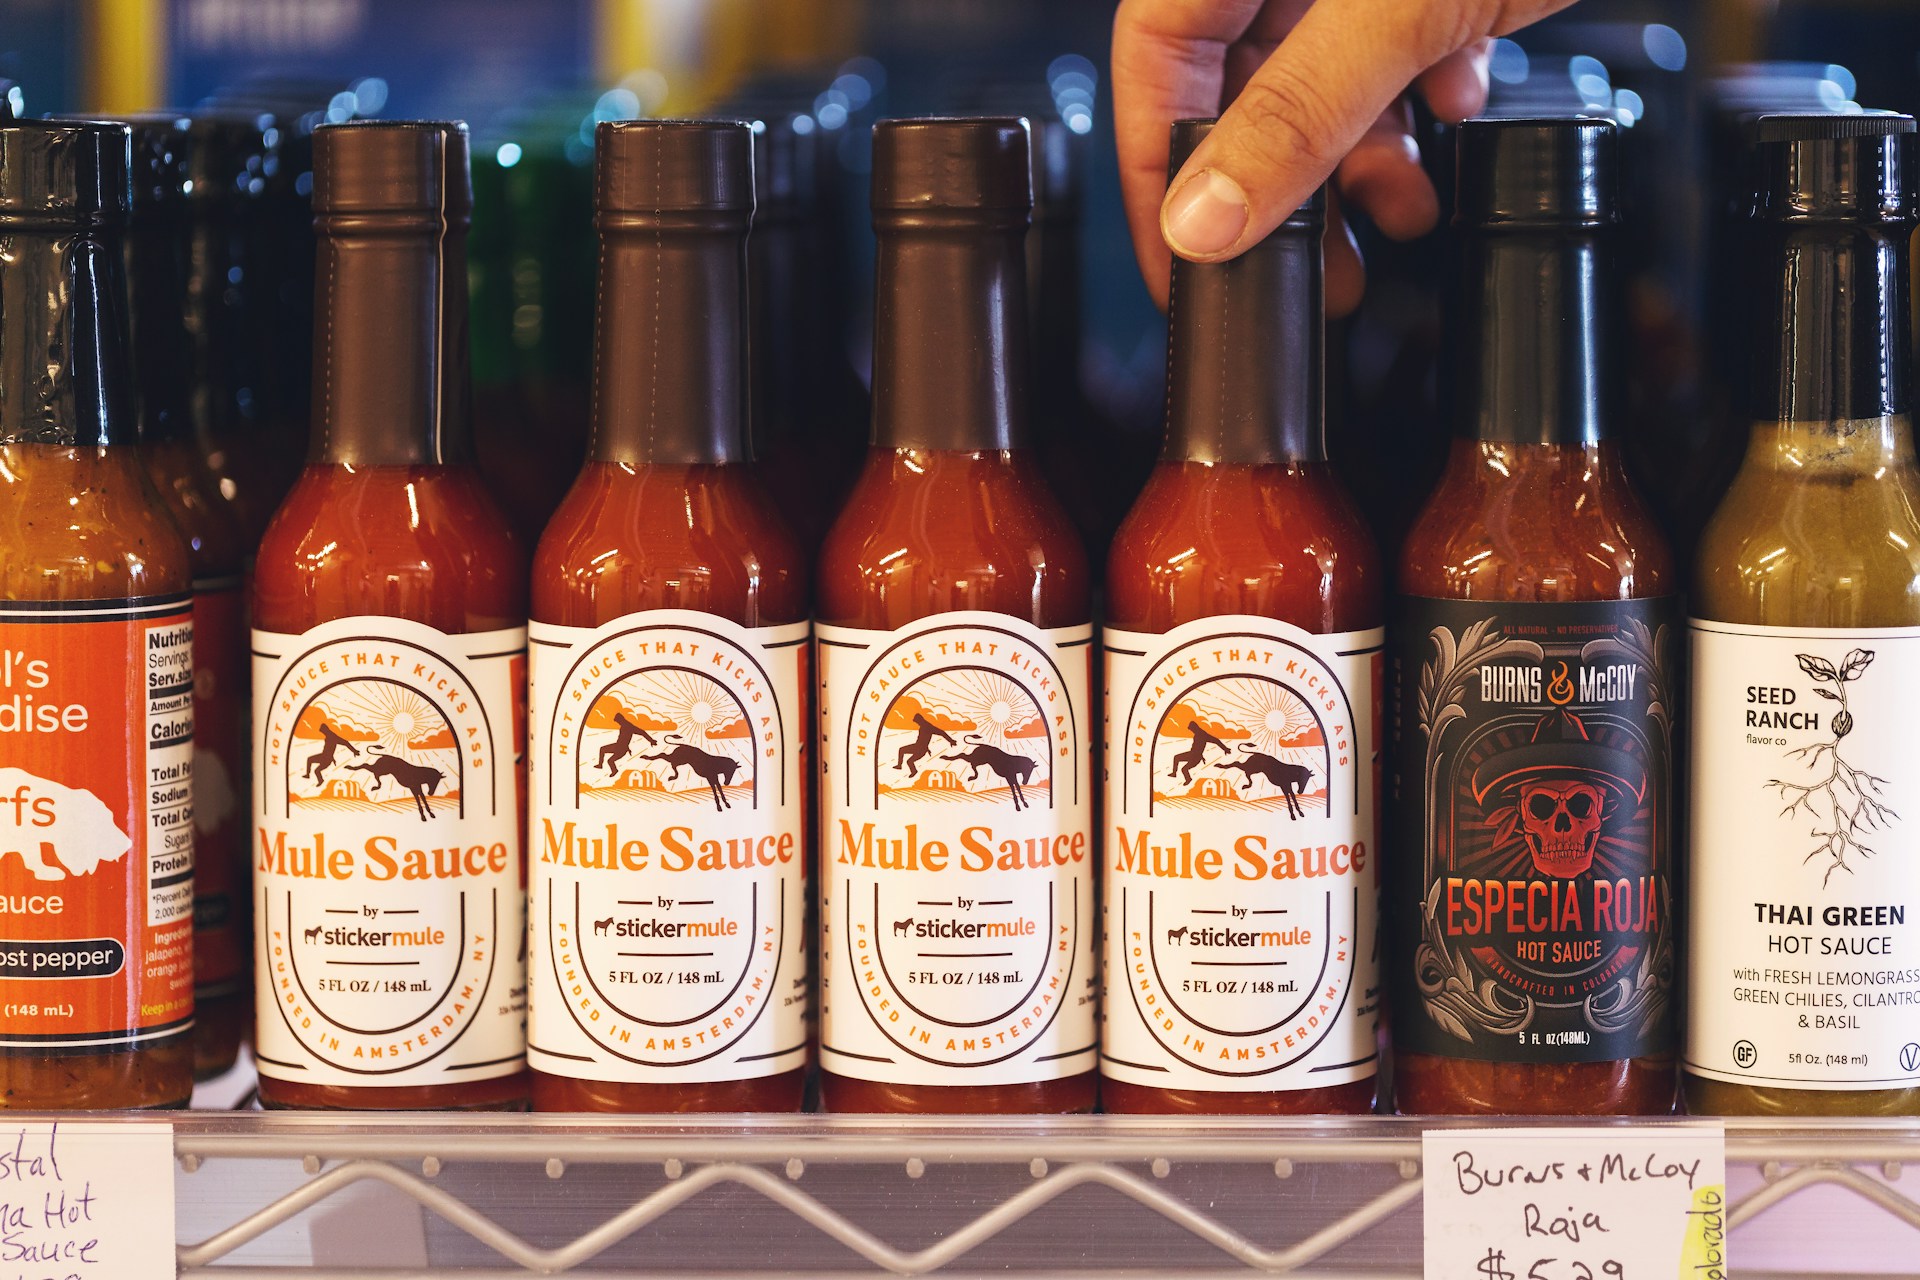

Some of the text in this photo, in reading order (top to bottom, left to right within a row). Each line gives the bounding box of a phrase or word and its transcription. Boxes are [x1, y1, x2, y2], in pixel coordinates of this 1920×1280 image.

[1504, 626, 1516, 634] ALL
[1518, 626, 1548, 634] NATURAL
[1557, 626, 1566, 634] NO
[0, 650, 49, 688] l's
[1481, 666, 1542, 703] BURNS
[1580, 664, 1636, 702] McCOY
[559, 643, 774, 758] HOT SAUCE THAT KICKS ASS
[857, 643, 1068, 757] HOT SAUCE THAT KICKS ASS
[1748, 686, 1796, 705] SEED
[271, 654, 483, 768] HOT SAUCE THAT KICKS ASS
[1133, 650, 1348, 766] HOT SAUCE THAT KICKS ASS
[1747, 710, 1818, 730] RANCH
[1747, 734, 1772, 744] flavor
[152, 765, 180, 781] Total
[152, 787, 188, 804] Sodium
[152, 810, 180, 827] Total
[258, 827, 508, 880] Mule Sauce
[541, 818, 793, 872] Mule Sauce
[837, 819, 1085, 872] Mule Sauce
[1115, 827, 1366, 880] Mule Sauce
[364, 905, 378, 919] by
[658, 896, 673, 910] by
[958, 897, 973, 911] by
[1232, 905, 1247, 919] by
[1447, 876, 1658, 936] ESPECIA ROJA
[1755, 903, 1904, 926] THAI GREEN
[325, 927, 444, 946] stickermule
[617, 918, 736, 937] stickermule
[916, 918, 1034, 938] stickermule
[1190, 927, 1310, 946] stickermule
[1517, 940, 1602, 963] HOT SAUCE
[1769, 935, 1892, 955] HOT SAUCE
[33, 950, 113, 971] pepper
[320, 979, 431, 992] 5 FL OZ / 148 mL
[559, 923, 600, 1022] FOUNDED
[609, 1025, 632, 1042] IN
[763, 926, 774, 952] NY
[610, 971, 724, 984] 5 FL OZ / 148 mL
[857, 924, 900, 1023] FOUNDED
[909, 1025, 931, 1043] IN
[1058, 926, 1069, 952] NY
[909, 971, 1022, 984] 5 FL OZ / 148 mL
[1733, 968, 1759, 982] with
[1765, 969, 1811, 984] FRESH
[274, 931, 311, 1030] FOUNDED
[320, 1031, 340, 1051] IN
[473, 934, 485, 960] NY
[1132, 932, 1174, 1031] FOUNDED
[1183, 1034, 1204, 1053] IN
[1336, 934, 1347, 961] NY
[1183, 981, 1298, 993] 5 FL OZ / 148 mL
[1565, 985, 1575, 995] IN
[1733, 988, 1779, 1005] GREEN
[1785, 992, 1847, 1009] CHILIES,
[4, 1004, 74, 1018] (148 mL)
[1798, 1014, 1860, 1029] & BASIL
[1519, 1032, 1525, 1044] 5
[1532, 1034, 1540, 1045] FL
[1738, 1046, 1752, 1062] GF
[1789, 1054, 1868, 1066] 5fl Oz. (148 ml)
[1453, 1151, 1565, 1194] Burns
[44, 1181, 96, 1228] Hot
[2, 1232, 98, 1263] Sauce
